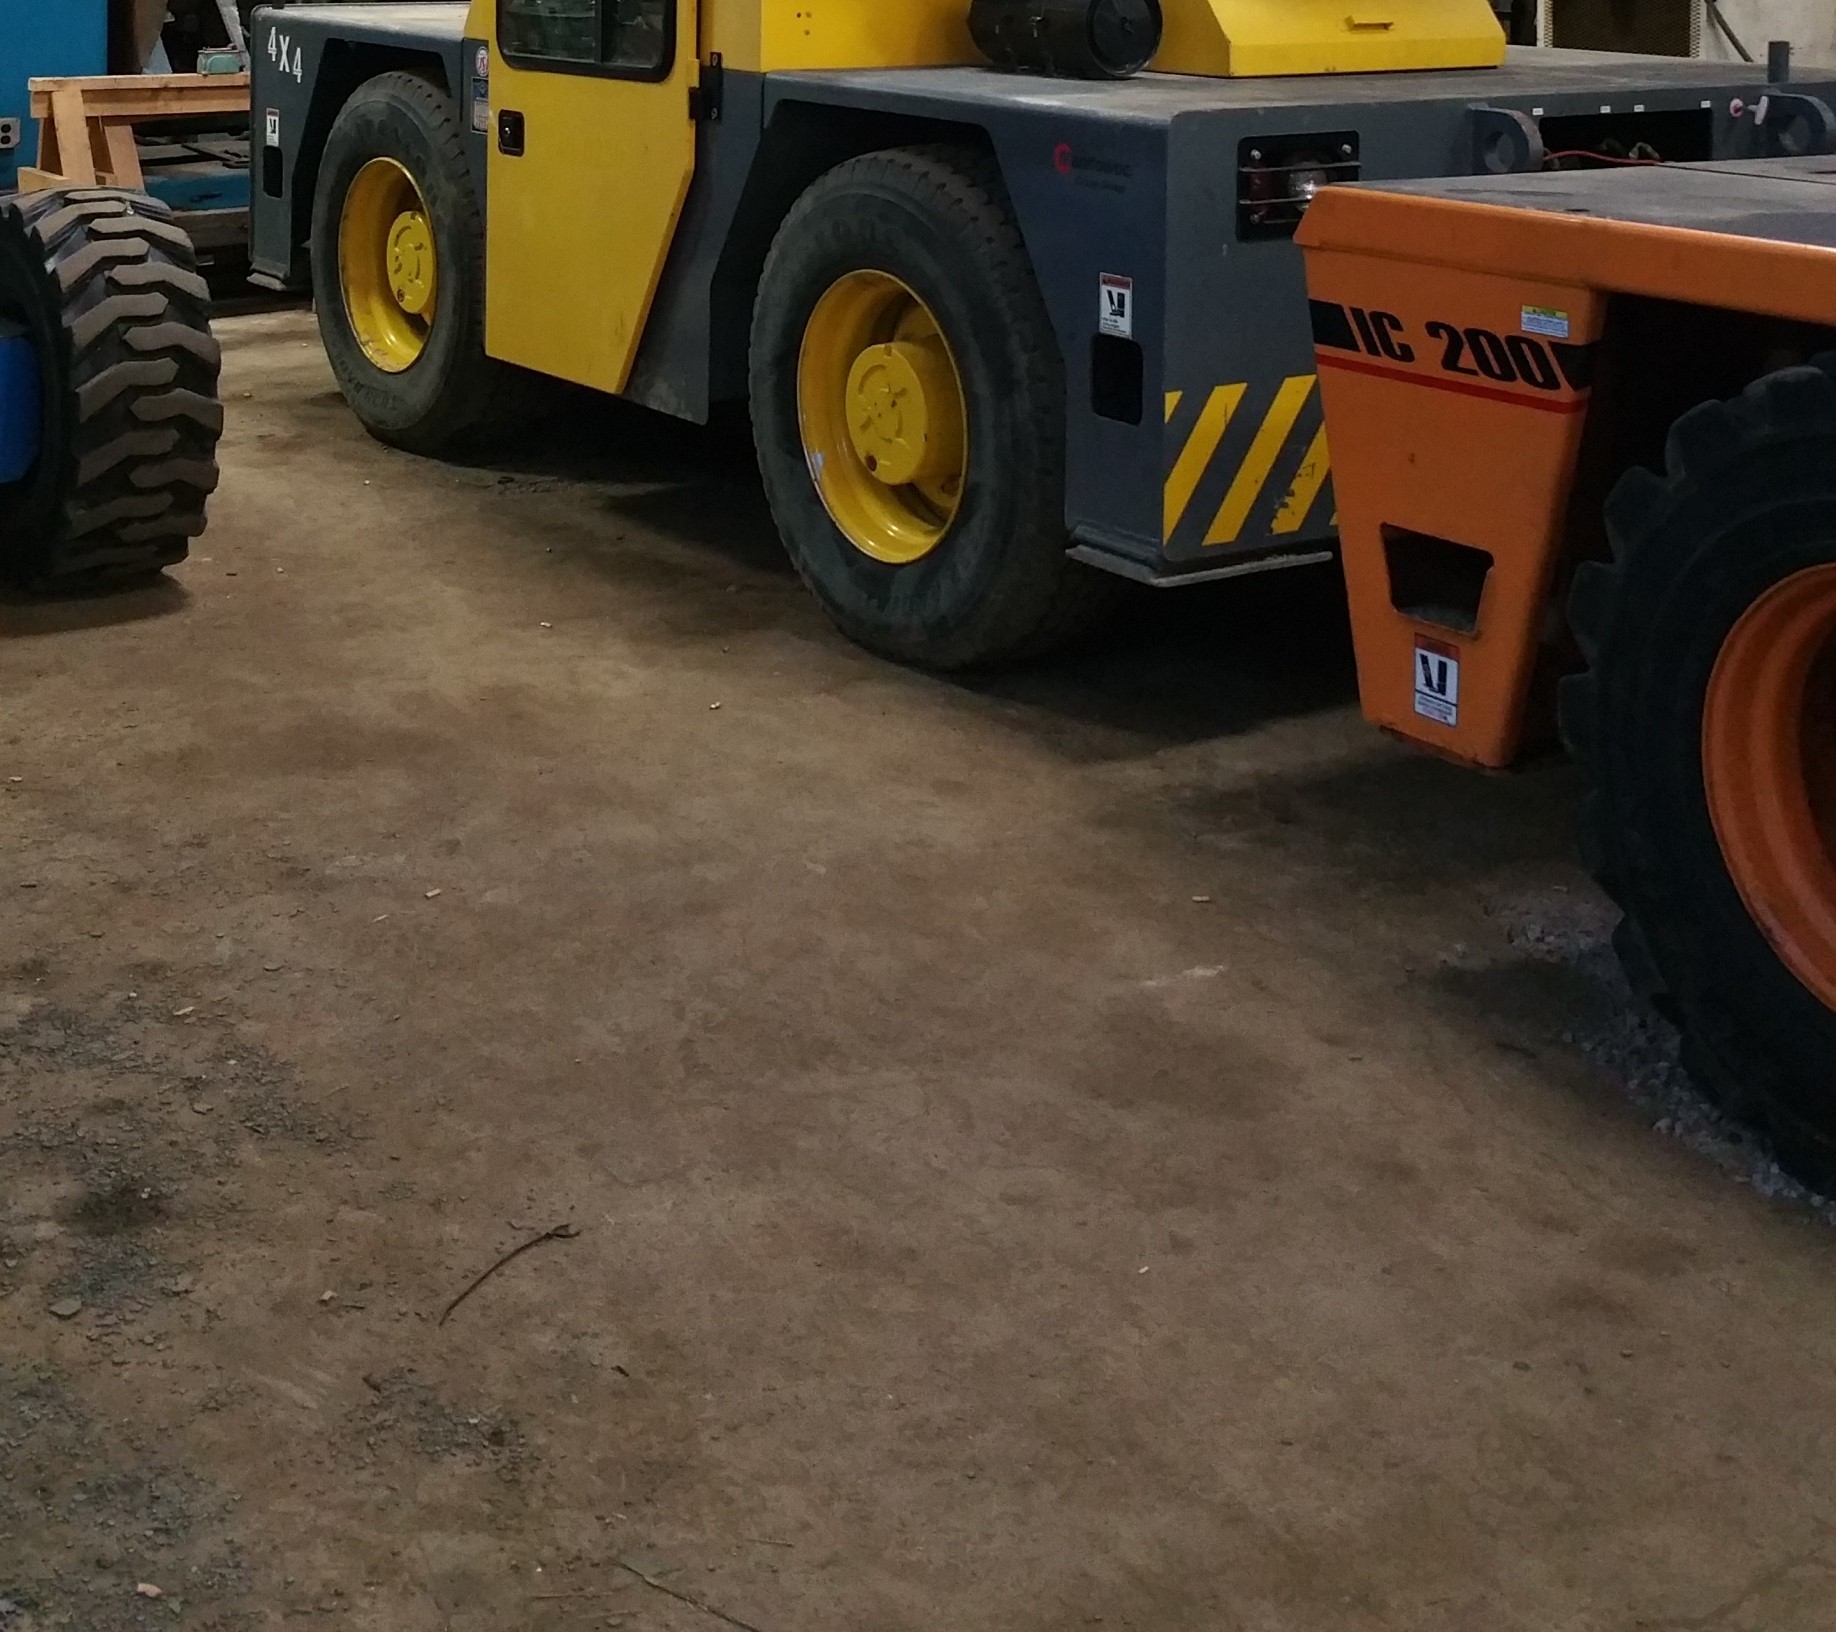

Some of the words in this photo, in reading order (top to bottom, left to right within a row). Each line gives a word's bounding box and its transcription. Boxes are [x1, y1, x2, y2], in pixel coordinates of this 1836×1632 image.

[267, 26, 303, 83] 4X4
[1349, 306, 1415, 363] IC
[1424, 320, 1561, 391] 200
